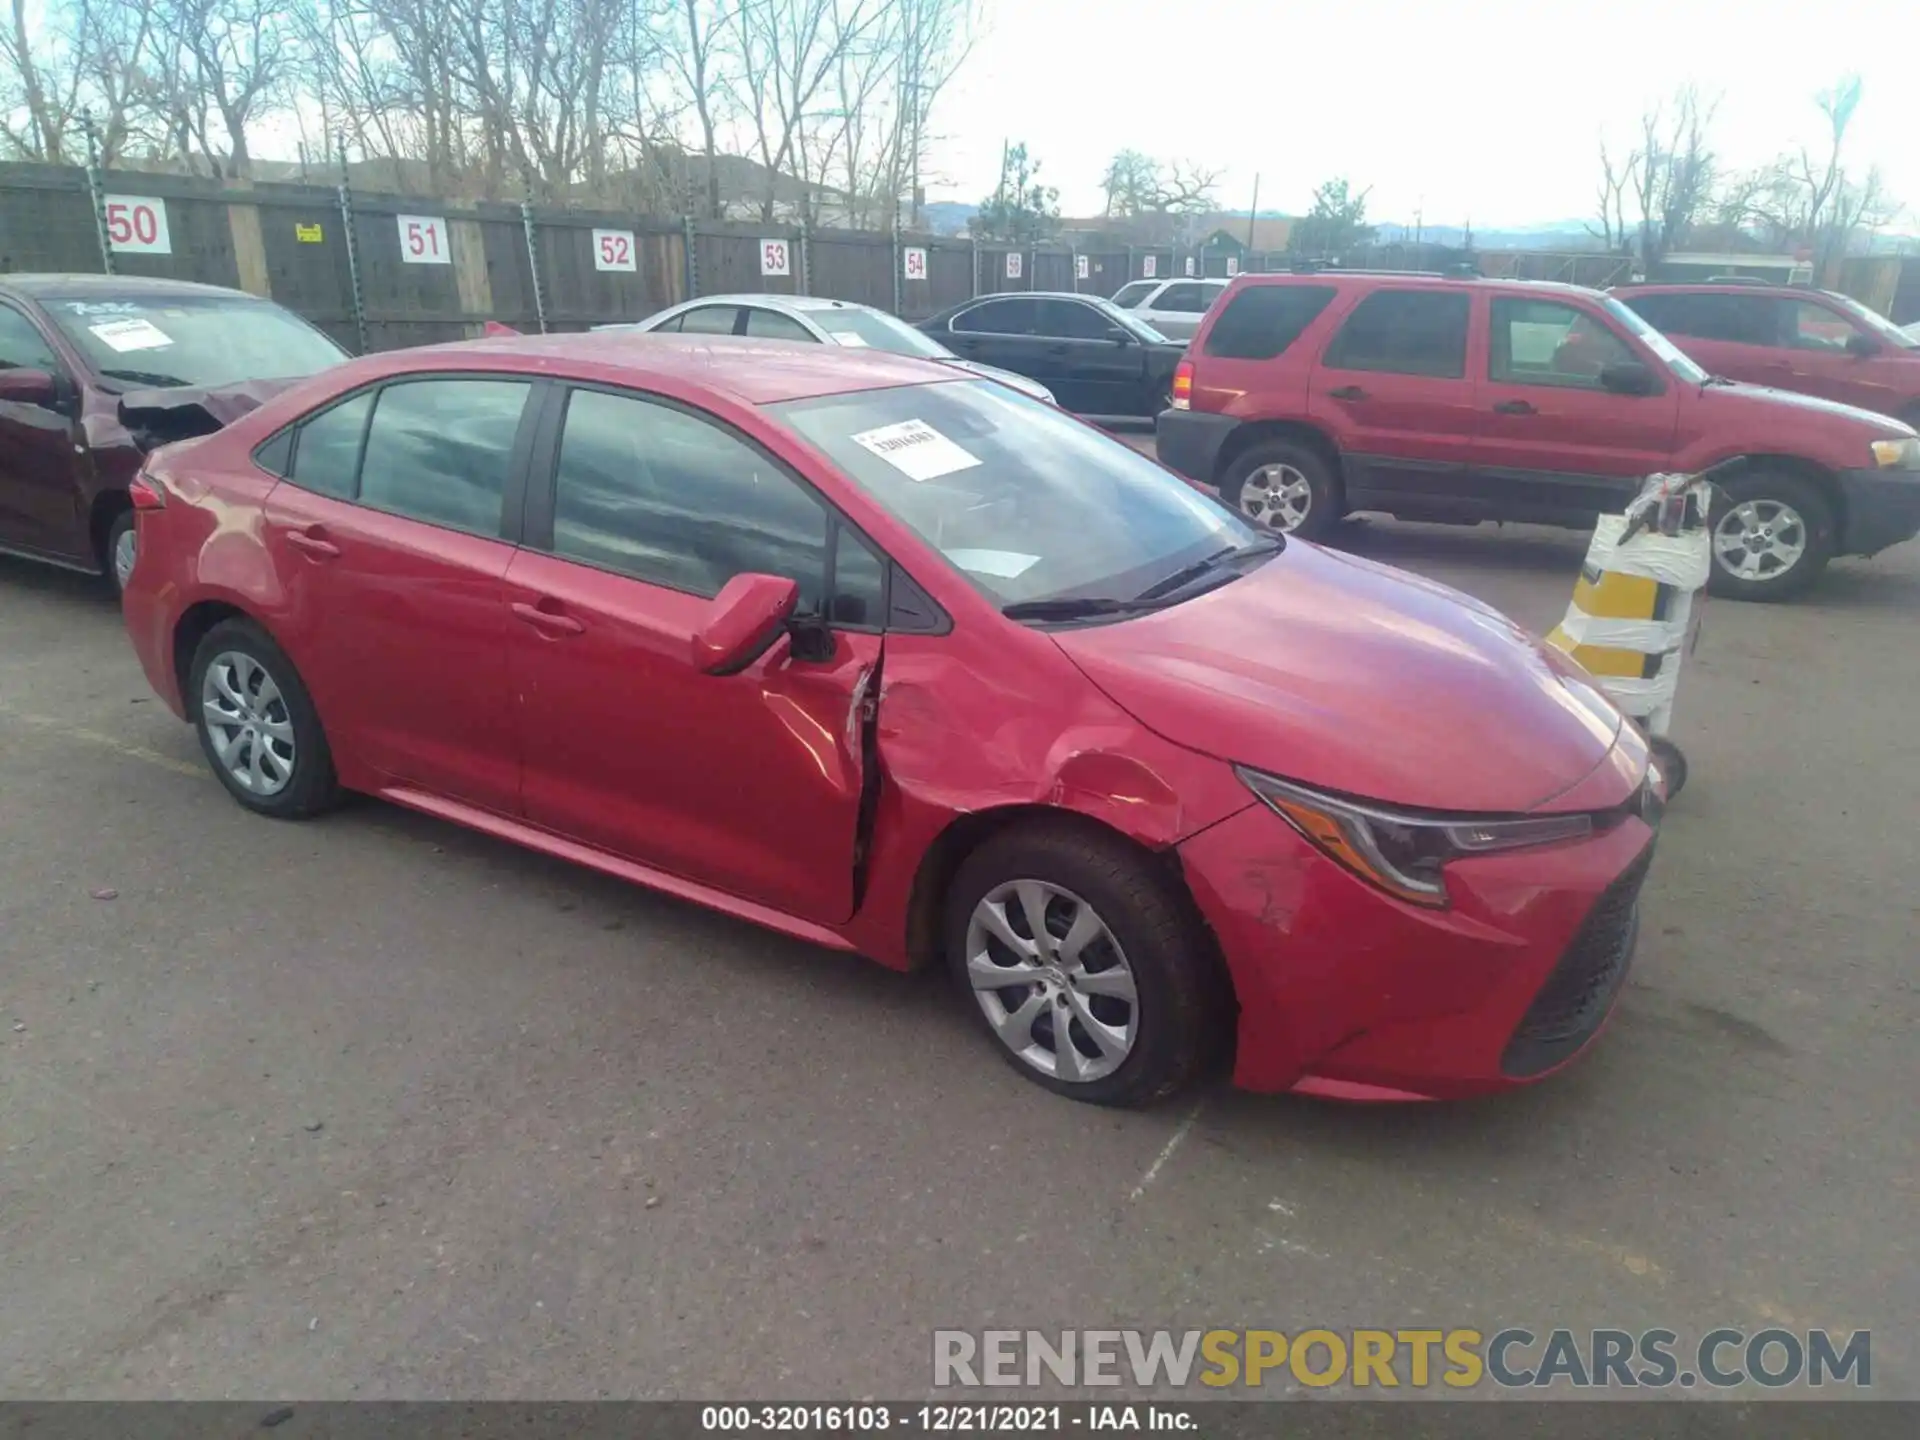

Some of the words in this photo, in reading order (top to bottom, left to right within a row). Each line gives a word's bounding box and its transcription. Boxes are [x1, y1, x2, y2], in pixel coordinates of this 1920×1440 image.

[108, 204, 157, 245] 50
[408, 223, 438, 256] 51
[600, 236, 629, 264] 52
[765, 244, 785, 269] 53
[907, 252, 924, 275] 54
